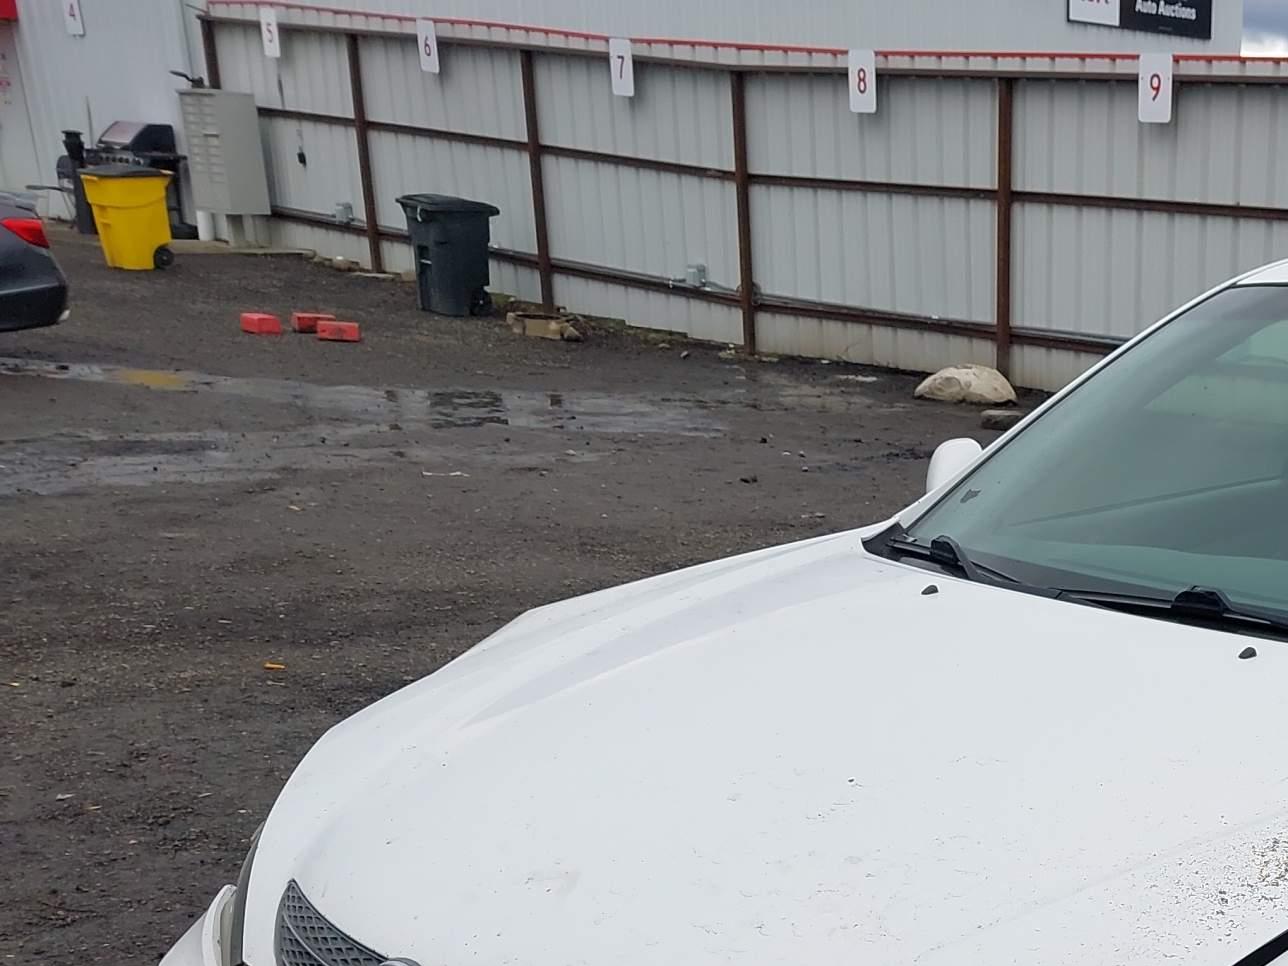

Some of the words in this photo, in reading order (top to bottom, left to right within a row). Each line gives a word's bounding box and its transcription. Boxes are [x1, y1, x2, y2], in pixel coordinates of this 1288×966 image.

[1135, 0, 1157, 14] Auto
[1158, 1, 1197, 20] Auctions
[265, 22, 273, 43] 5
[423, 36, 432, 57] 6
[616, 54, 625, 80] 7
[857, 67, 868, 95] 8
[1149, 73, 1162, 102] 9
